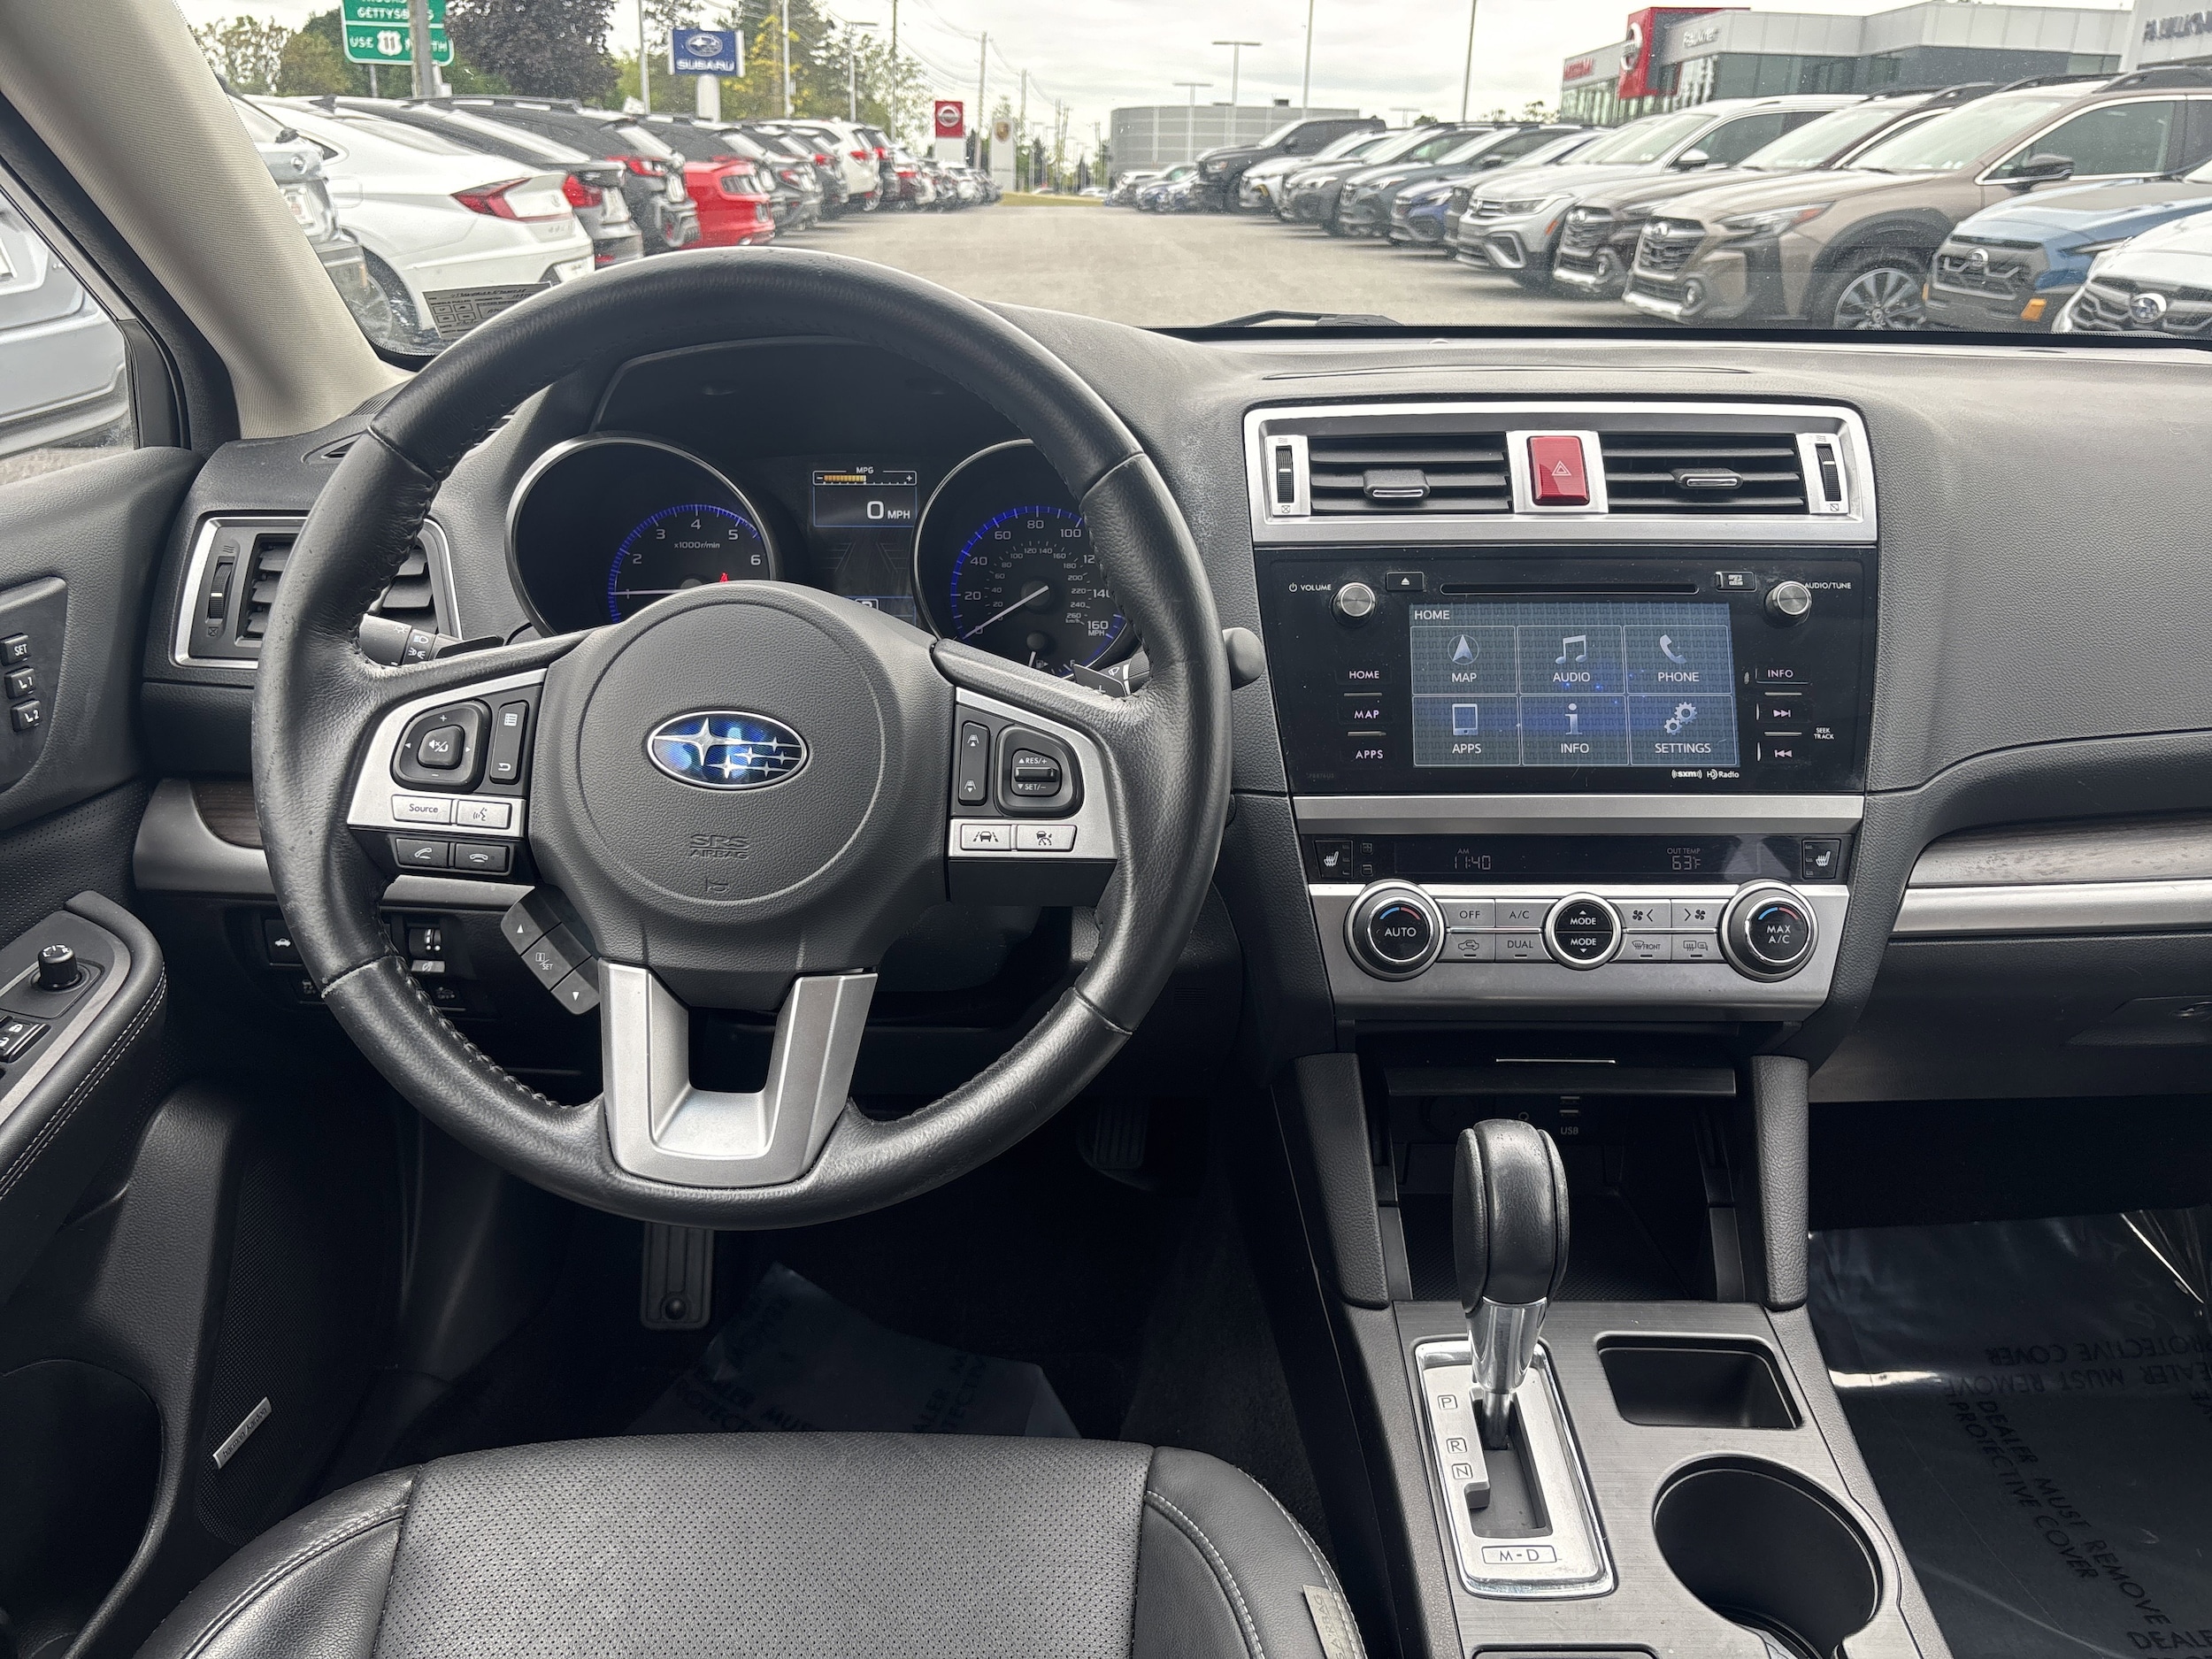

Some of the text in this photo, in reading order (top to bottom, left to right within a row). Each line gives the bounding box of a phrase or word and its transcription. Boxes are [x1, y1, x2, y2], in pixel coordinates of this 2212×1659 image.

[349, 36, 373, 49] USE
[383, 36, 395, 50] 11
[676, 58, 735, 71] SUBARU
[866, 501, 910, 520] 0 MPH
[691, 518, 702, 530] 4
[1026, 520, 1044, 529] 80
[656, 529, 666, 540] 3
[728, 529, 739, 541] 5
[994, 531, 1011, 540] 60
[1060, 529, 1081, 538] 100
[633, 553, 642, 565] 2
[750, 555, 761, 565] 6
[970, 557, 987, 565] 40
[1083, 555, 1095, 564] 12
[964, 591, 981, 600] 20
[1414, 610, 1450, 619] HOME
[1087, 620, 1109, 630] 160
[14, 643, 28, 657] SET
[1349, 670, 1380, 679] HOME
[1451, 672, 1477, 682] MAP
[1553, 672, 1591, 682] AUDIO
[1657, 672, 1700, 682] PHONE
[1767, 669, 1793, 678] INFO
[1354, 710, 1379, 718] MAP
[1452, 743, 1481, 754] APPS
[1560, 743, 1589, 754] INFO
[1655, 742, 1711, 754] SETTINGS
[1355, 749, 1383, 759] APPS
[409, 803, 439, 813] Source
[689, 833, 750, 849] SRS
[689, 849, 749, 859] AIRBAG
[1454, 856, 1491, 870] 11:40
[1460, 910, 1480, 919] OFF
[1509, 910, 1530, 919] A/C
[1570, 917, 1596, 926] MODE
[1384, 927, 1417, 937] AUTO
[1766, 925, 1792, 934] MAX
[1507, 940, 1534, 949] DUAL
[1768, 935, 1790, 944] A/C
[1560, 1126, 1578, 1135] USB
[1987, 1344, 2069, 1366] COVER
[2141, 1362, 2212, 1386] EALER
[2059, 1368, 2124, 1393] MUST
[1441, 1397, 1452, 1408] P
[1451, 1440, 1463, 1451] R
[1455, 1466, 1469, 1477] N
[1948, 1401, 2100, 1580] PROTECTIVE COVER
[1977, 1401, 2171, 1625] DEALER MUST REMOVE
